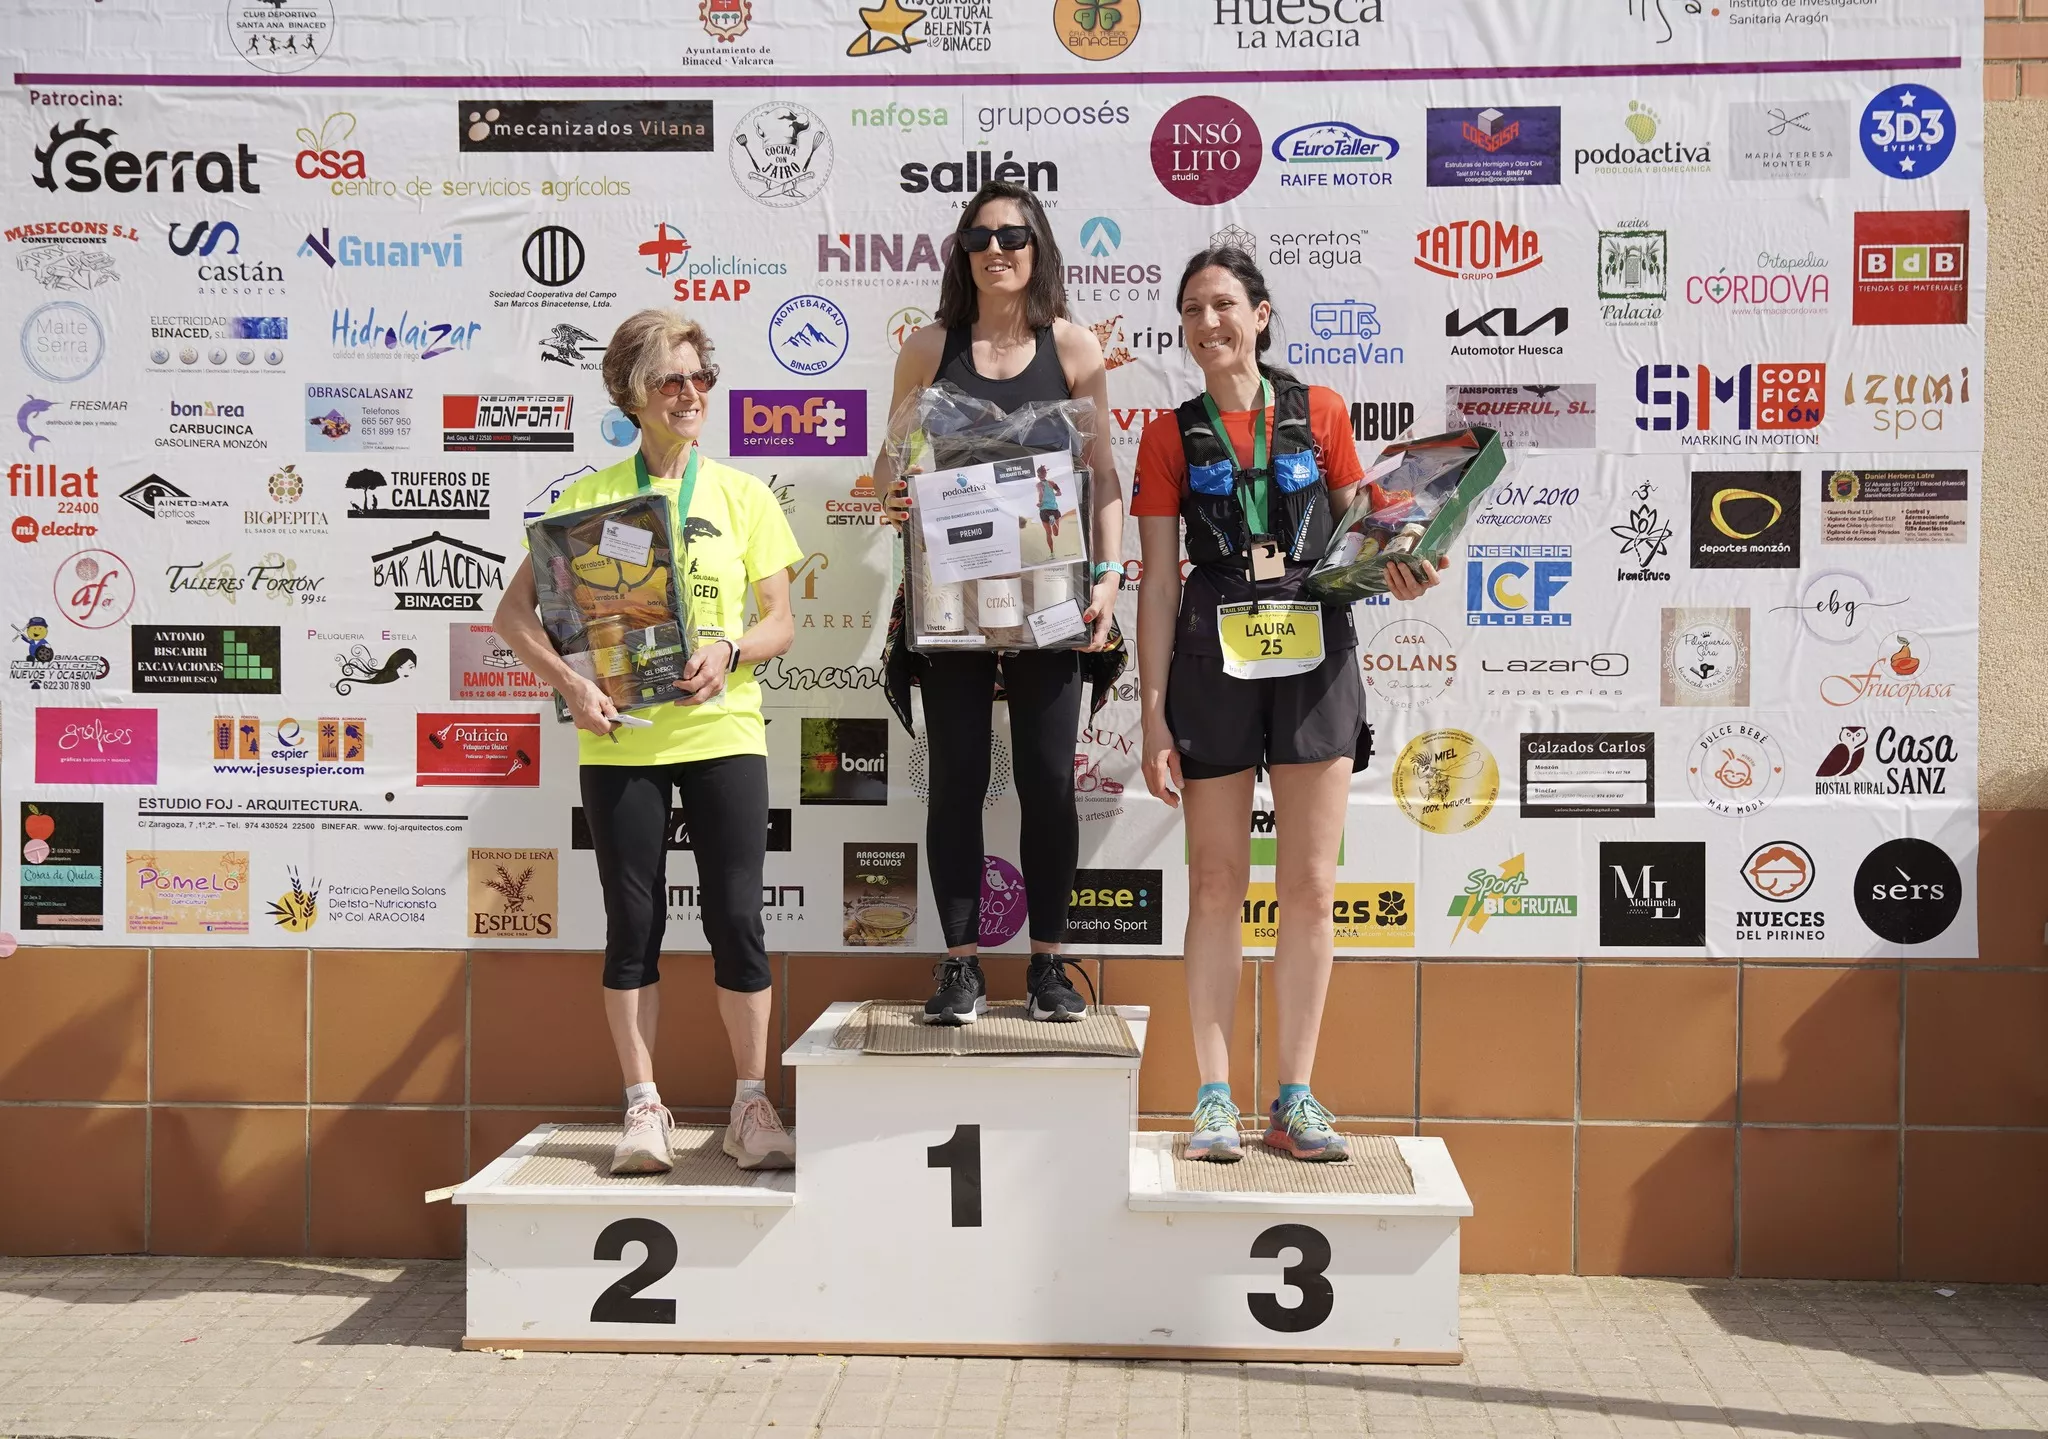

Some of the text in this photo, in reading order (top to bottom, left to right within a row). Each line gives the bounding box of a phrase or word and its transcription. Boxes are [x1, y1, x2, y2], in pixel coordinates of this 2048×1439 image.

[931, 6, 993, 20] CULTURAL
[1730, 12, 1828, 25] Sanitaria Aragón
[925, 21, 991, 36] BELENISTA
[682, 57, 774, 66] Binaced Valcarca
[30, 91, 123, 106] Patrocina:
[978, 101, 1129, 134] grupoosés
[495, 121, 706, 136] mecanizados Vilana
[1173, 119, 1242, 145] INSÓ
[1871, 110, 1945, 146] 3D3
[1293, 140, 1379, 157] EuroTaller
[296, 149, 366, 180] csa
[1173, 150, 1241, 171] LITO
[1575, 142, 1710, 174] podoactiva
[65, 143, 260, 194] serrat
[762, 161, 800, 180] JAIRO
[900, 151, 1058, 193] sallén
[1172, 173, 1199, 181] studio
[1281, 173, 1392, 186] RAIFE MOTOR
[332, 176, 630, 202] centro de servicios agrícolas
[1617, 218, 1650, 228] aceites
[4, 222, 108, 243] MASECONS
[339, 234, 462, 267] Guarvi
[1415, 220, 1538, 269] TATOMA
[1270, 248, 1361, 270] del agua
[1758, 252, 1829, 272] Ortopedia
[198, 262, 284, 282] castán
[689, 256, 787, 279] policlínicas
[1462, 272, 1493, 280] GRUPO
[674, 278, 751, 301] SEAP
[1687, 267, 1829, 304] CÓRDOVA
[527, 291, 572, 299] Cooperativa
[591, 291, 617, 299] Campo
[775, 298, 844, 328] MONTEBARRAU
[1600, 304, 1664, 321] Palacio
[36, 319, 88, 335] Maite
[150, 317, 227, 326] ELECTRICIDAD
[1446, 307, 1568, 336] KIA
[37, 337, 88, 353] Serra
[1451, 345, 1563, 356] Automotor Huesca
[1288, 343, 1404, 364] CincaVan
[1762, 368, 1820, 384] CODI
[1636, 364, 1751, 430] SM
[1762, 388, 1819, 402] FICA
[70, 401, 128, 411] FRESMAR
[1762, 404, 1819, 422] CIÓN
[478, 406, 565, 427] MONFORT
[744, 397, 824, 434] bnf
[170, 424, 253, 435] CARBUCINCA
[1873, 410, 1942, 439] spa
[154, 438, 268, 448] GASOLINERA MONZÓN
[744, 437, 794, 445] services
[1682, 434, 1819, 446] MARKING IN MOTION!
[7, 464, 99, 498] fillat
[392, 472, 490, 486] TRUFEROS DE
[392, 490, 490, 507] CALASANZ
[942, 484, 986, 500] podoactiva
[1534, 488, 1579, 505] 2010
[57, 502, 99, 514] 22400
[158, 508, 195, 519] ópticos
[960, 528, 982, 538] PREMIO
[1700, 542, 1790, 554] deportes monzón
[166, 561, 324, 594] TALLERES FORTÓN
[374, 549, 504, 591] BAR ALACENA
[1467, 562, 1571, 612] ICF
[404, 595, 474, 608] BINACED
[986, 594, 1016, 609] crush.
[1817, 589, 1862, 626] ebg
[927, 624, 946, 632] Vivette
[1469, 614, 1571, 626] GLOBAL
[154, 632, 204, 642] ANTONIO
[308, 630, 417, 640] PELUQUERIA ESTELA
[1246, 623, 1296, 637] LAURA
[1261, 639, 1283, 656] 25
[1395, 636, 1425, 644] CASA
[154, 647, 207, 656] BISCARRI
[1697, 645, 1718, 661] Sara
[138, 662, 224, 672] EXCAVACIONES
[656, 665, 674, 674] ENERGY
[1363, 654, 1457, 672] SOLANS
[1820, 658, 1955, 706] Frucopasa
[455, 729, 508, 742] Patricia
[1701, 725, 1770, 749] DULCE BEBÉ
[1528, 741, 1646, 753] Calzados Carlos
[1876, 726, 1958, 765] Casa
[271, 749, 309, 761] espier
[842, 753, 884, 772] barri
[1435, 748, 1457, 762] MIEL
[214, 764, 364, 777] www.jesusespier.com
[1816, 782, 1885, 795] HOSTAL RURAL
[1887, 768, 1946, 795] SANZ
[139, 798, 362, 811] ESTUDIO FOJ ARQUITECTURA.
[1707, 799, 1766, 814] MAX MODA
[1086, 807, 1124, 822] artesanas
[1464, 869, 1527, 895] Sport
[1872, 866, 1945, 900] sèrs
[329, 886, 446, 896] Patricia Penella Solans
[1484, 898, 1572, 914] BIOFRUTAL
[474, 913, 552, 935] ESPLÚS
[1736, 912, 1825, 926] NUECES
[1736, 930, 1825, 940] DEL PIRINEO
[927, 1125, 981, 1228] 1
[590, 1218, 678, 1324] 2
[1247, 1223, 1334, 1332] 3
